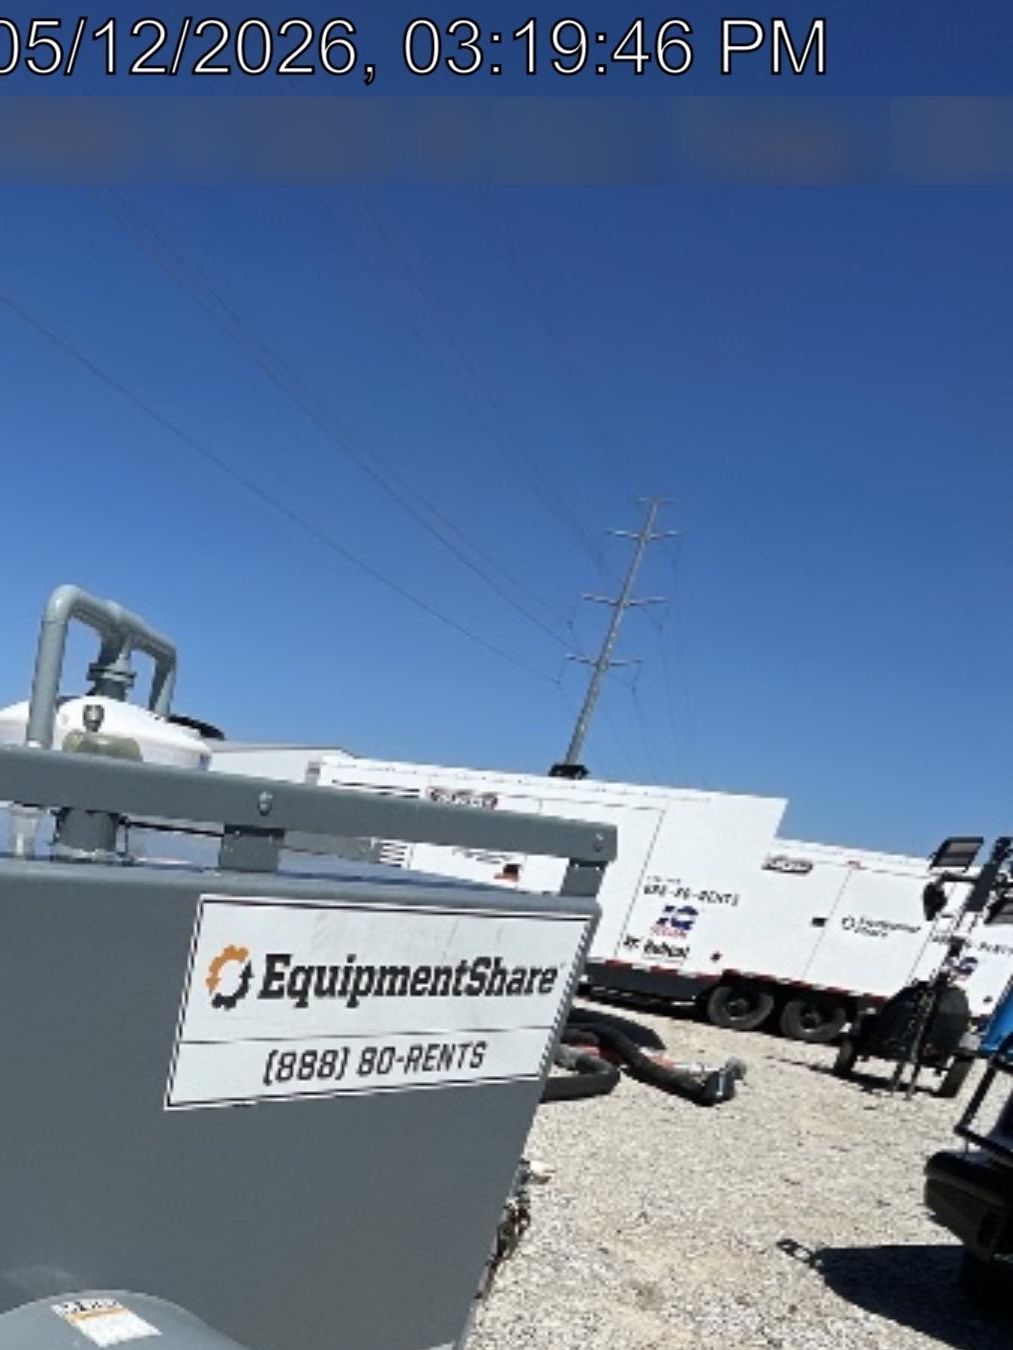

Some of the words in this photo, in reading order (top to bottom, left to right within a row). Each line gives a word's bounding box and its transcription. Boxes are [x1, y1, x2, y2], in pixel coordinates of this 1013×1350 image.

[256, 952, 559, 1009] EquipmentShare
[262, 1047, 350, 1087] (888)
[356, 1041, 487, 1078] 80-RENTS
